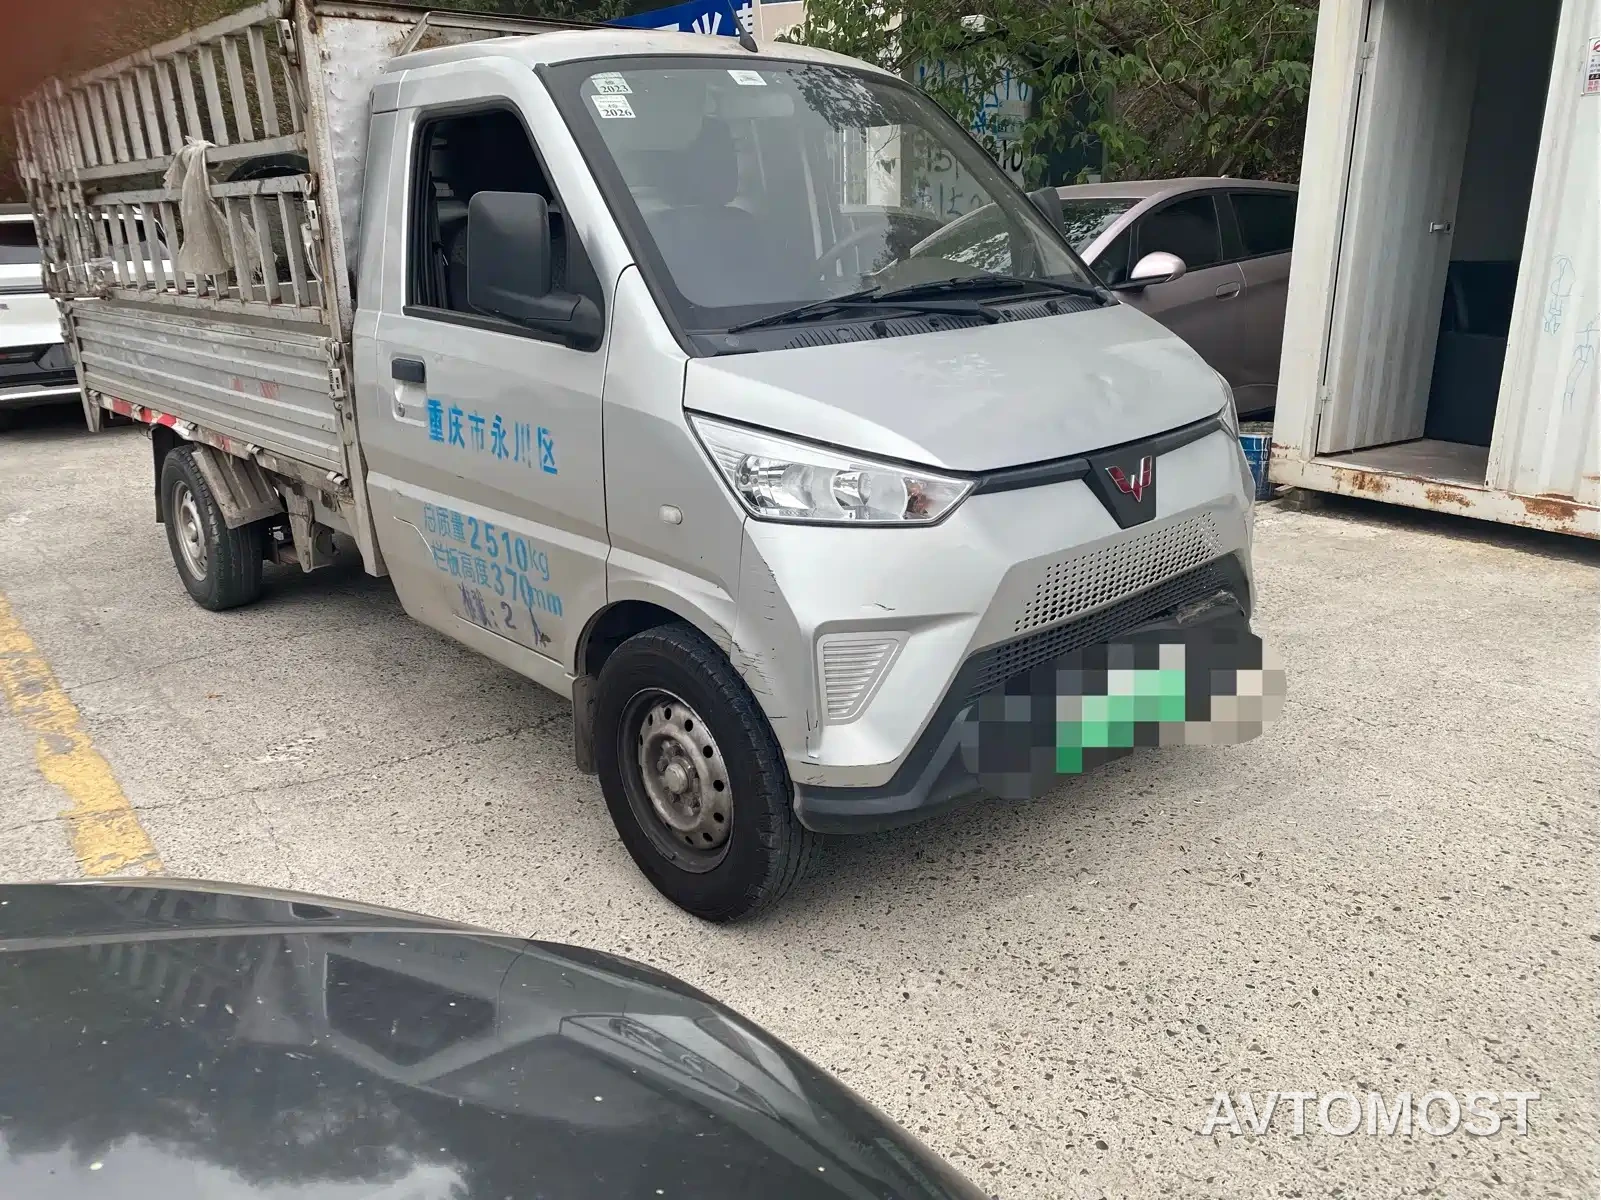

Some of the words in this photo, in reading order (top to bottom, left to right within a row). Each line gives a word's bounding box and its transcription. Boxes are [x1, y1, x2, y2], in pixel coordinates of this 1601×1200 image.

[600, 85, 629, 93] 2023
[602, 109, 632, 117] 2026
[427, 398, 558, 475] 重庆市永川区
